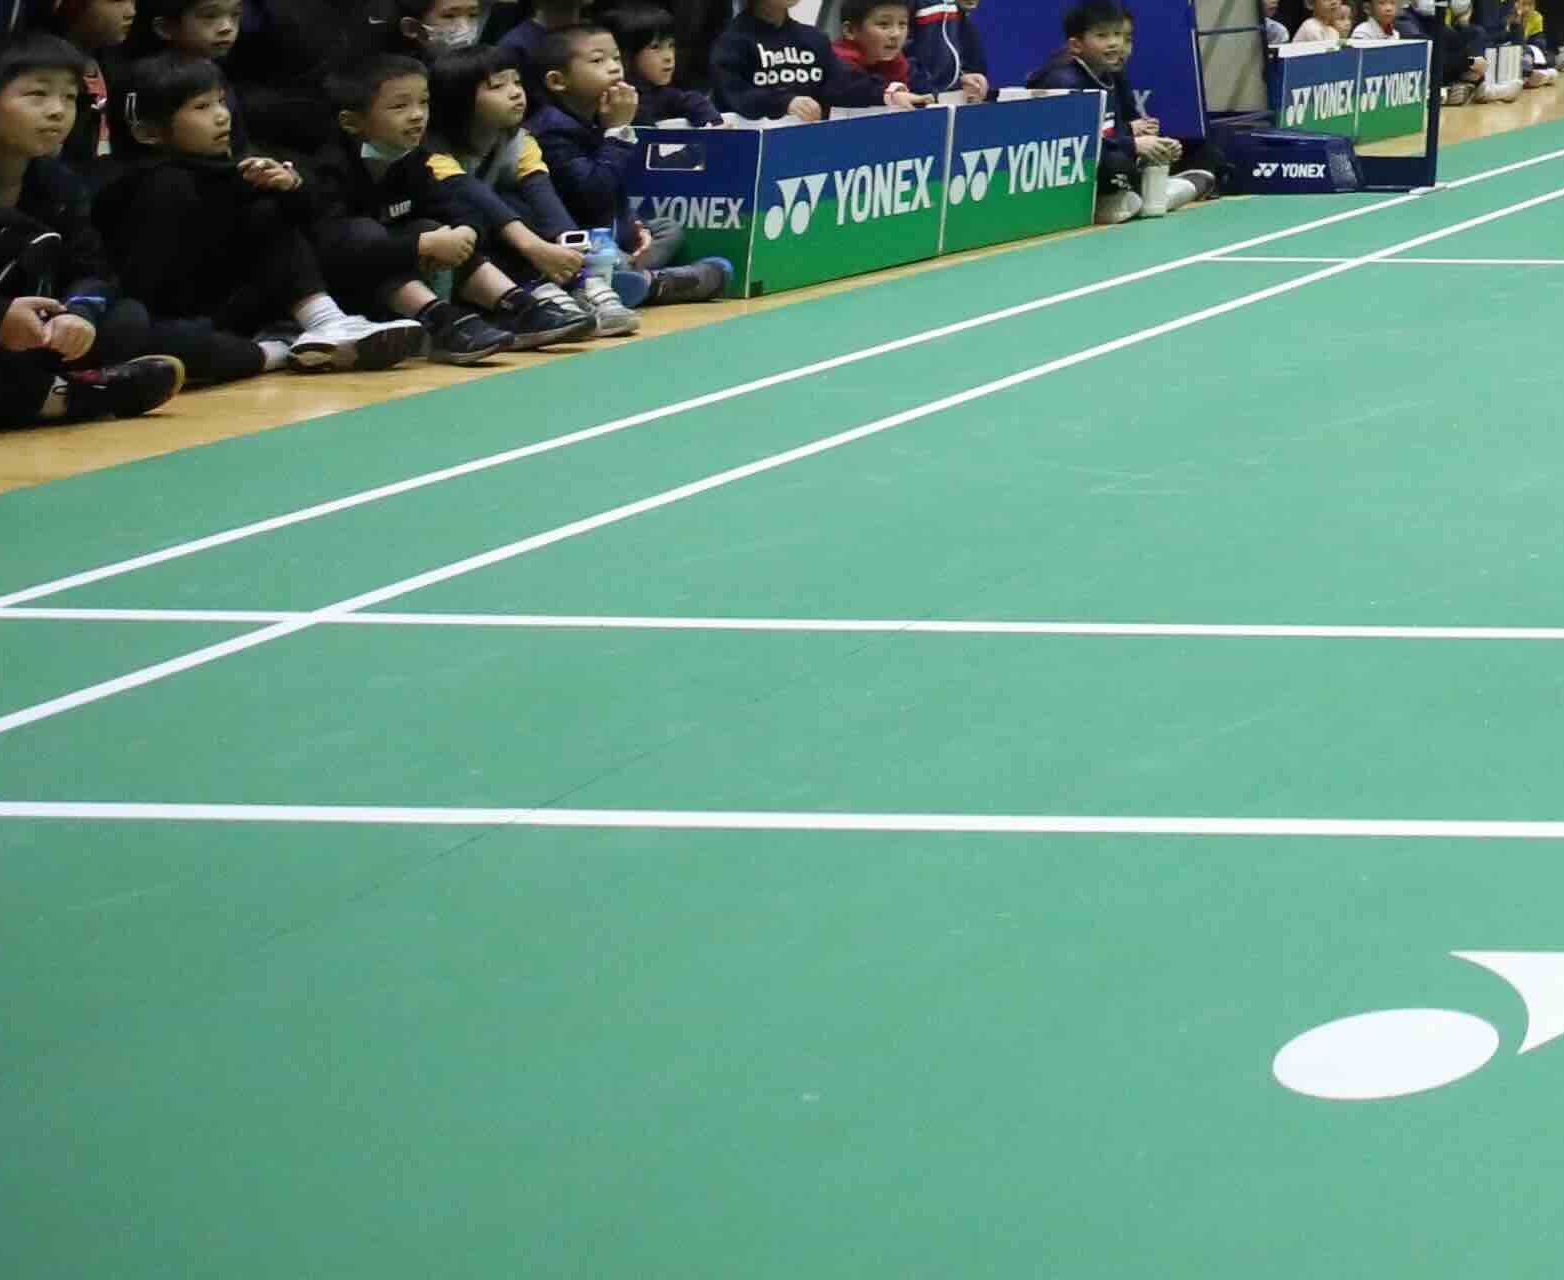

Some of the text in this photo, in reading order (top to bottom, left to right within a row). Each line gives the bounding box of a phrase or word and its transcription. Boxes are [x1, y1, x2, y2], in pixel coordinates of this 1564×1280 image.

[757, 43, 815, 68] hello
[1313, 79, 1355, 121] YONEX
[1384, 71, 1423, 109] YONEX
[1007, 135, 1089, 195] YONEX
[1281, 163, 1326, 179] YONEX
[834, 156, 934, 226] YONEX
[651, 196, 745, 230] YONEX
